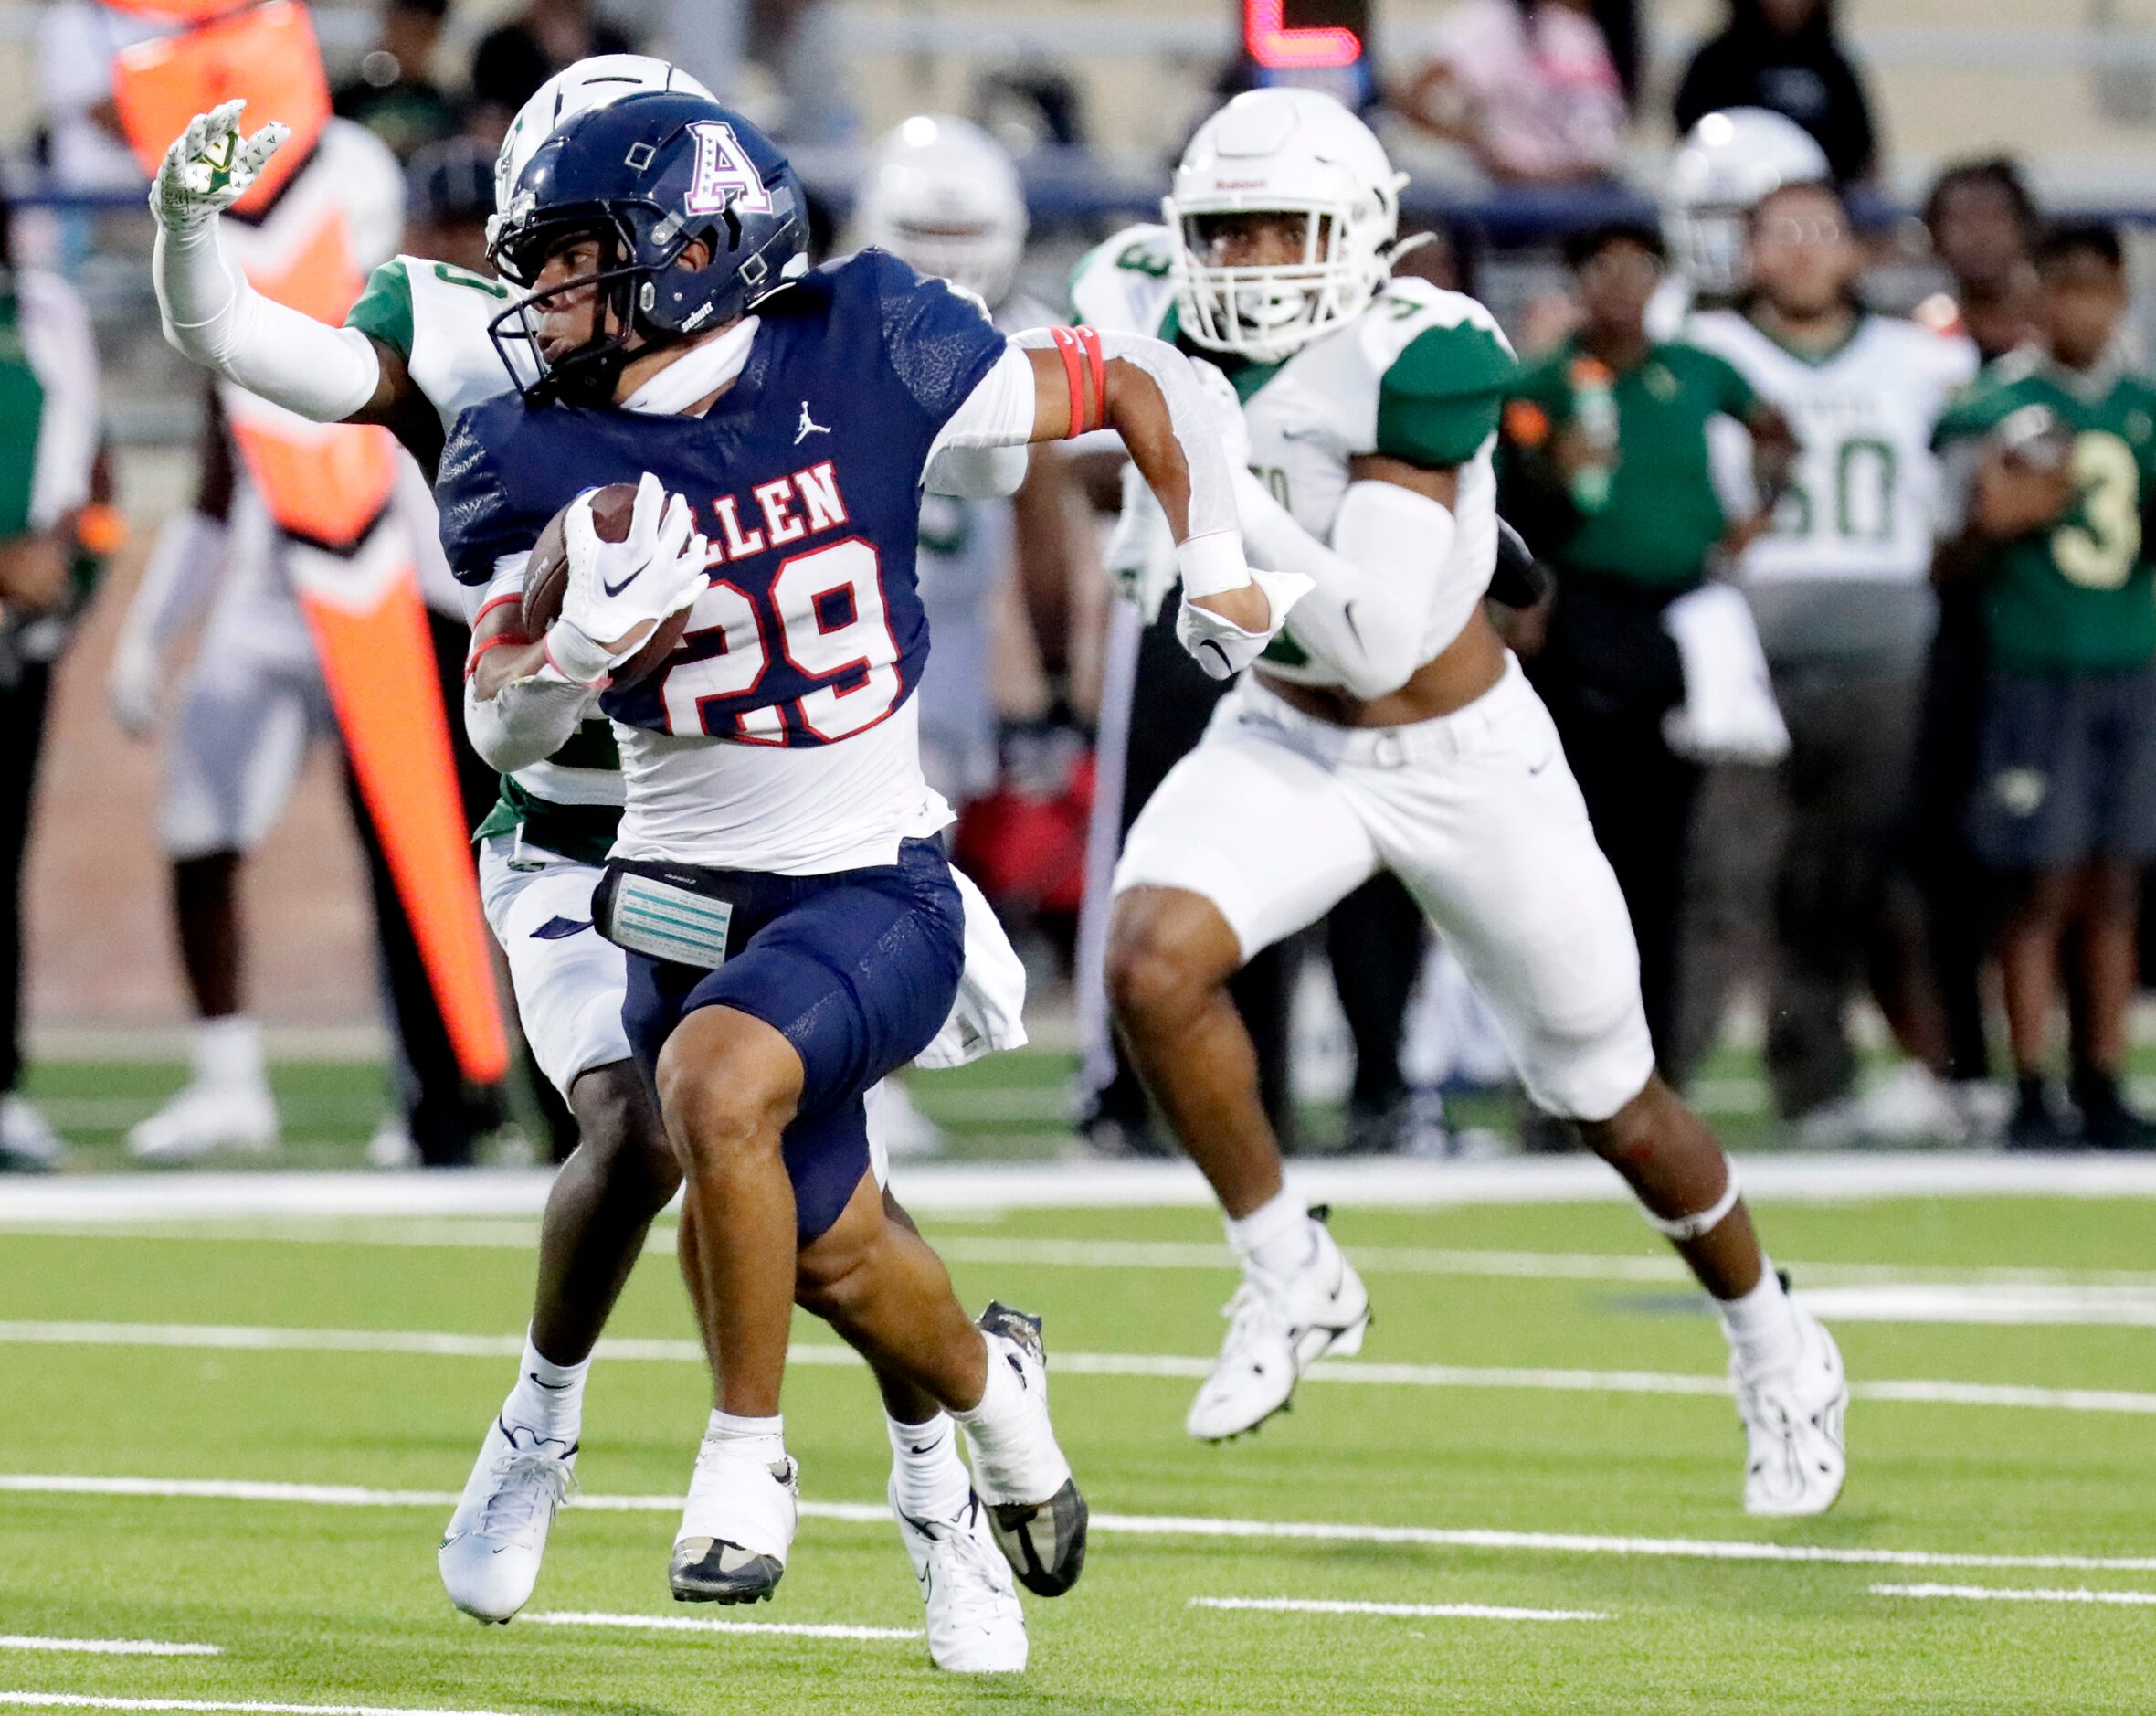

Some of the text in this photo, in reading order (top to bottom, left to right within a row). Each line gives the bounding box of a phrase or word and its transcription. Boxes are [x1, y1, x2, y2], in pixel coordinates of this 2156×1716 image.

[685, 119, 774, 217] A
[682, 301, 714, 333] schutt
[660, 535, 904, 747] 29
